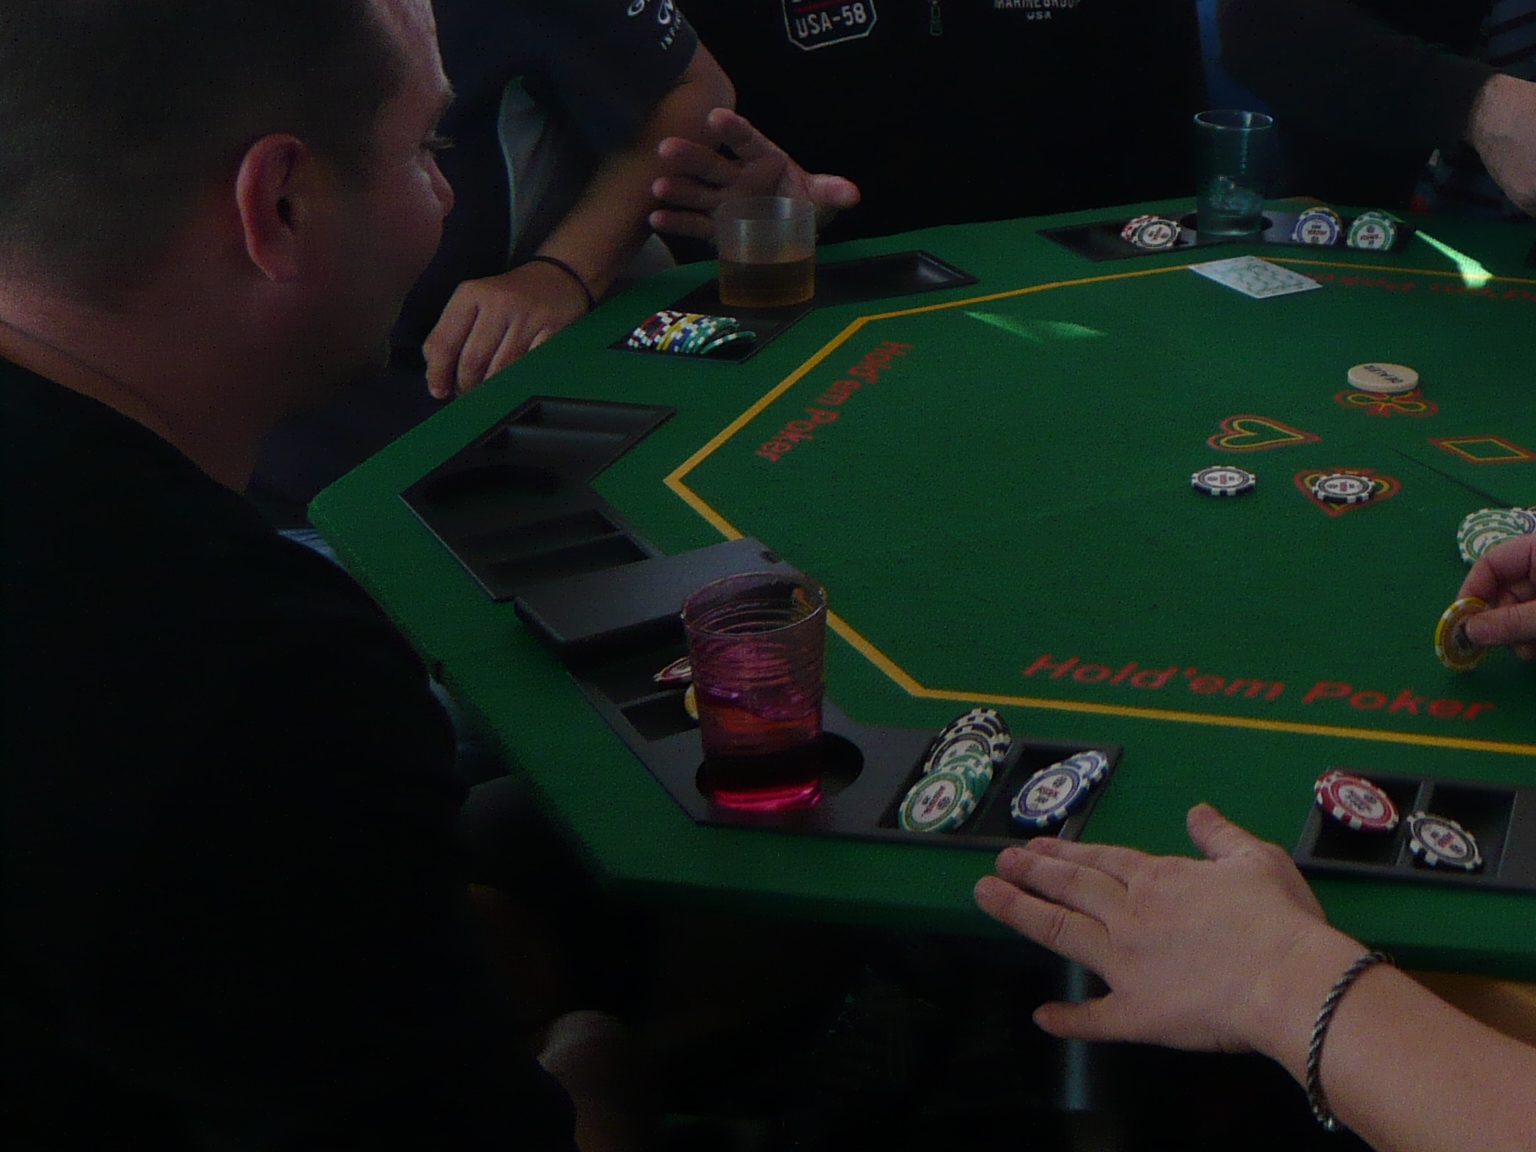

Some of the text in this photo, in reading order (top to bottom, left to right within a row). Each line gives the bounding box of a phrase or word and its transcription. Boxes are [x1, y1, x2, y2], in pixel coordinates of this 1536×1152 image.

[795, 1, 868, 39] USA-58
[1027, 11, 1051, 20] USA
[754, 407, 840, 463] Poker
[1022, 654, 1494, 721] Hold'em Poker
